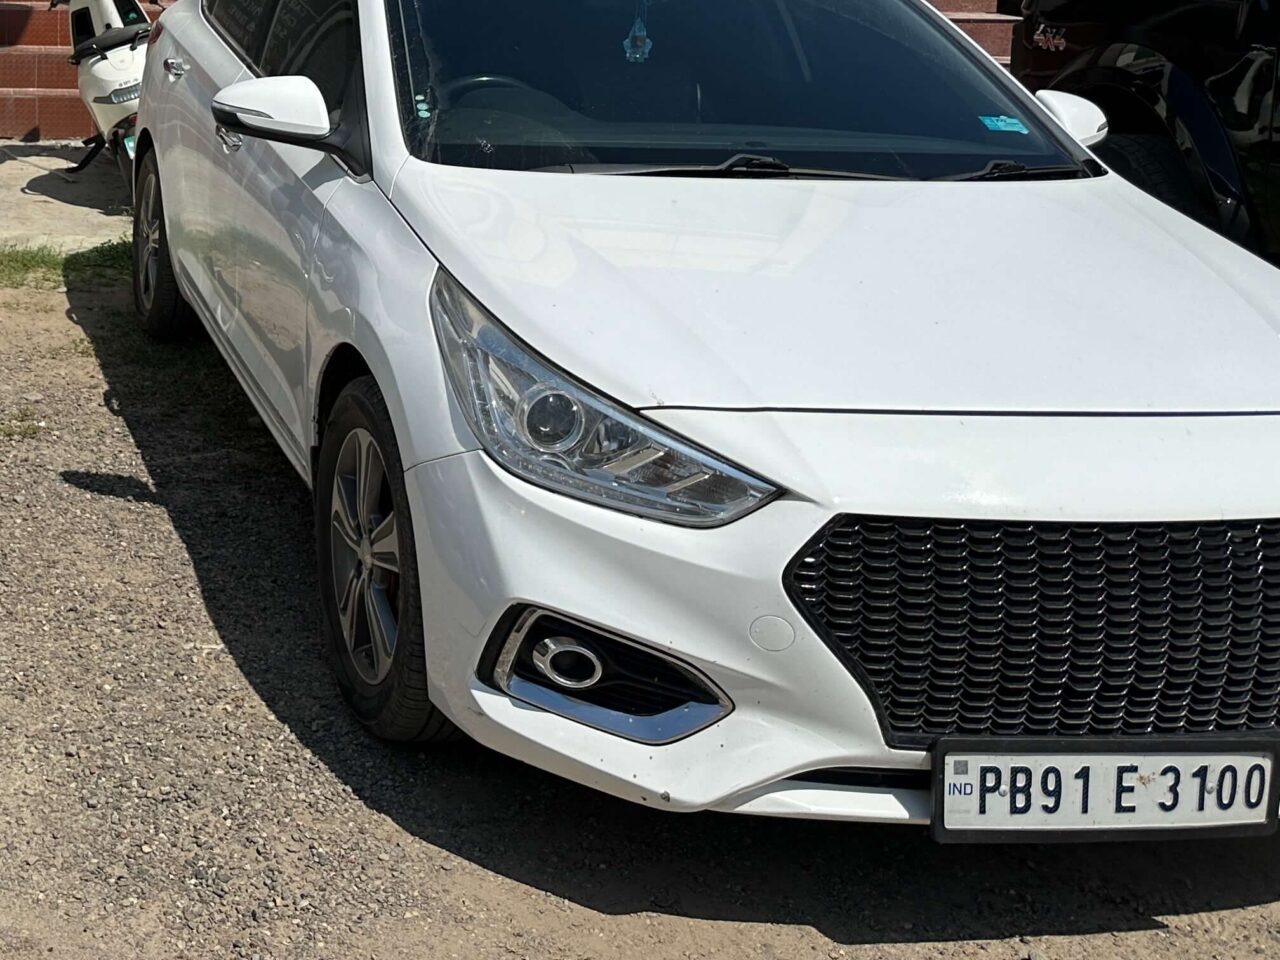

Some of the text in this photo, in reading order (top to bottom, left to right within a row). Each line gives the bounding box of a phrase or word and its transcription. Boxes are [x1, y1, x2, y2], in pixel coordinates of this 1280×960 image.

[948, 782, 973, 796] IND
[978, 763, 1266, 815] PB91 E 3100
